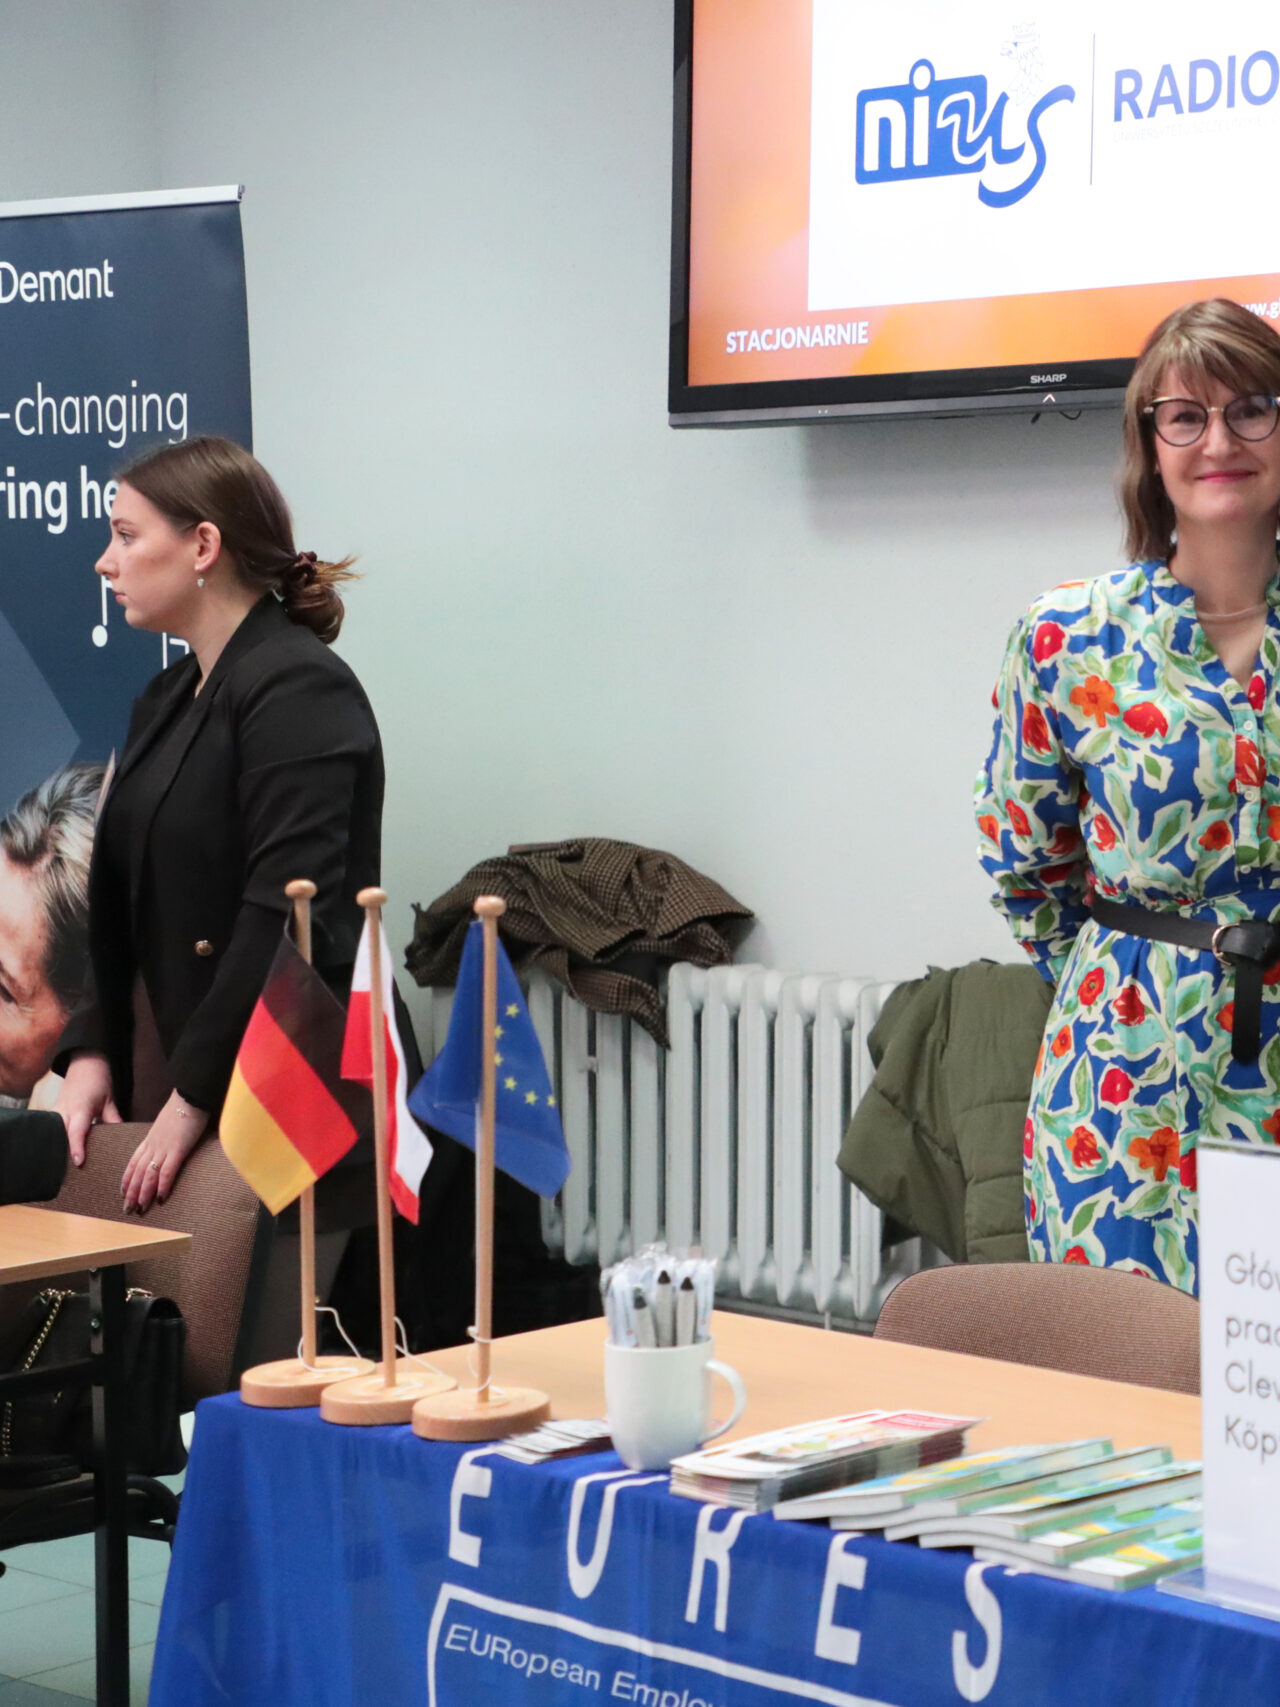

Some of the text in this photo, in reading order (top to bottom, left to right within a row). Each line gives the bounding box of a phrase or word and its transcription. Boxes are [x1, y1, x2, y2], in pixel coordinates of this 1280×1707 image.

[1113, 50, 1280, 122] RADIO
[0, 258, 114, 304] Demant
[725, 320, 870, 354] STACJONARNIE
[1029, 373, 1067, 384] SHARP
[443, 1623, 601, 1691] EURopean
